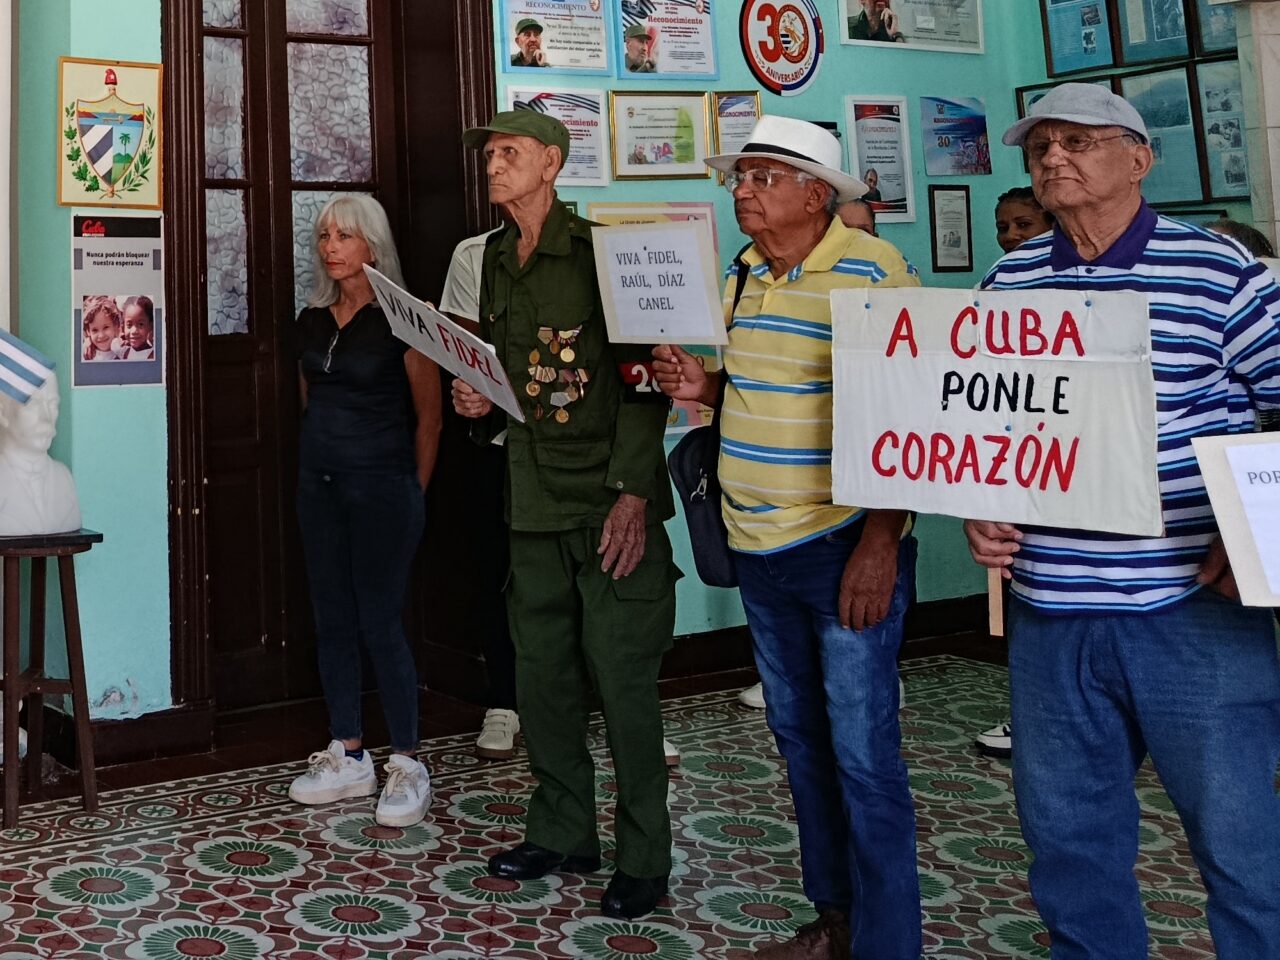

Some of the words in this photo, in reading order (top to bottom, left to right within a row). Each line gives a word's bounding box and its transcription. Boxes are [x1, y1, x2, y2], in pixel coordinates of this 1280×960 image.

[525, 1, 587, 12] RECONOCIMIENTO
[765, 66, 804, 83] ANIVERSARIO
[104, 251, 125, 259] podrán
[125, 251, 150, 260] bloquear
[115, 260, 144, 268] esperanza
[615, 251, 642, 266] VIVA
[647, 250, 683, 265] FIDEL,
[620, 271, 652, 289] RAÚL,
[657, 270, 686, 288] DÍAZ
[638, 296, 675, 311] CANEL
[376, 284, 435, 343] VIVA
[436, 322, 503, 386] FIDEL
[885, 306, 918, 359] A
[950, 305, 1086, 360] CUBA
[941, 370, 1070, 415] PONLE
[870, 421, 1081, 493] CORAZÓN
